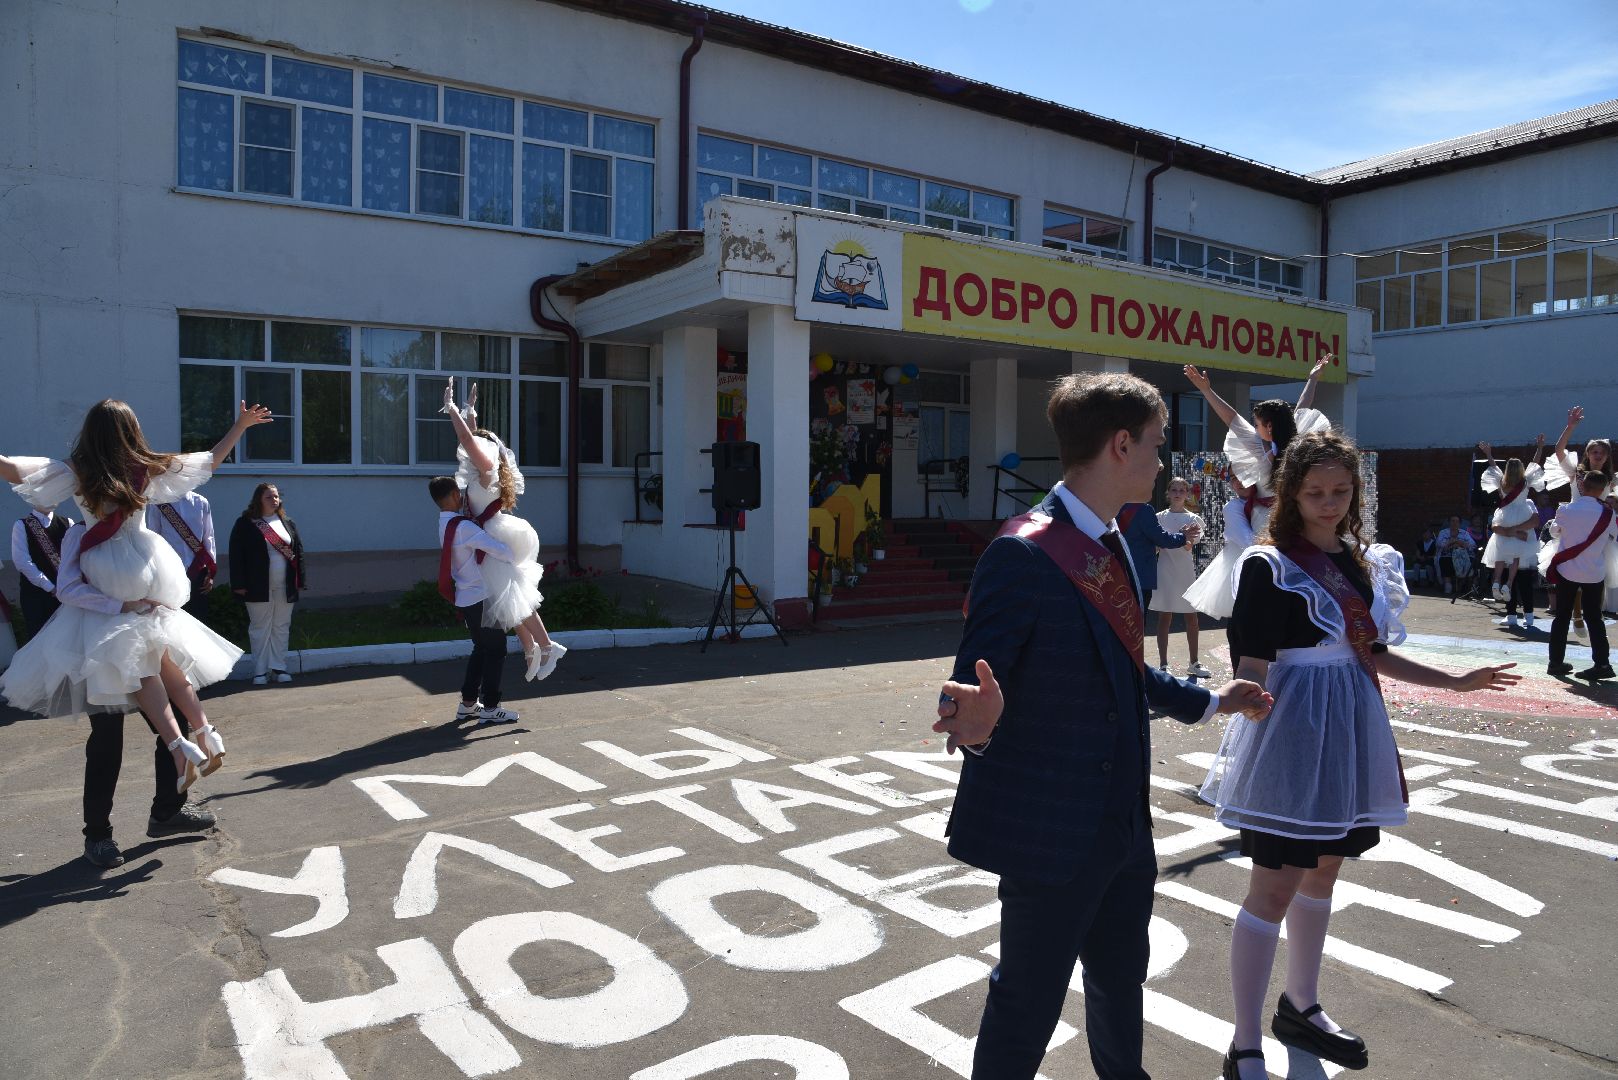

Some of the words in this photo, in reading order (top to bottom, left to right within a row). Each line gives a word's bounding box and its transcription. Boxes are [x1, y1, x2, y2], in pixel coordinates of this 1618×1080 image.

[913, 265, 1078, 330] ДОБРО
[1090, 293, 1340, 368] ПОЖАЛОВАТЬ!
[352, 726, 777, 821] МЫ
